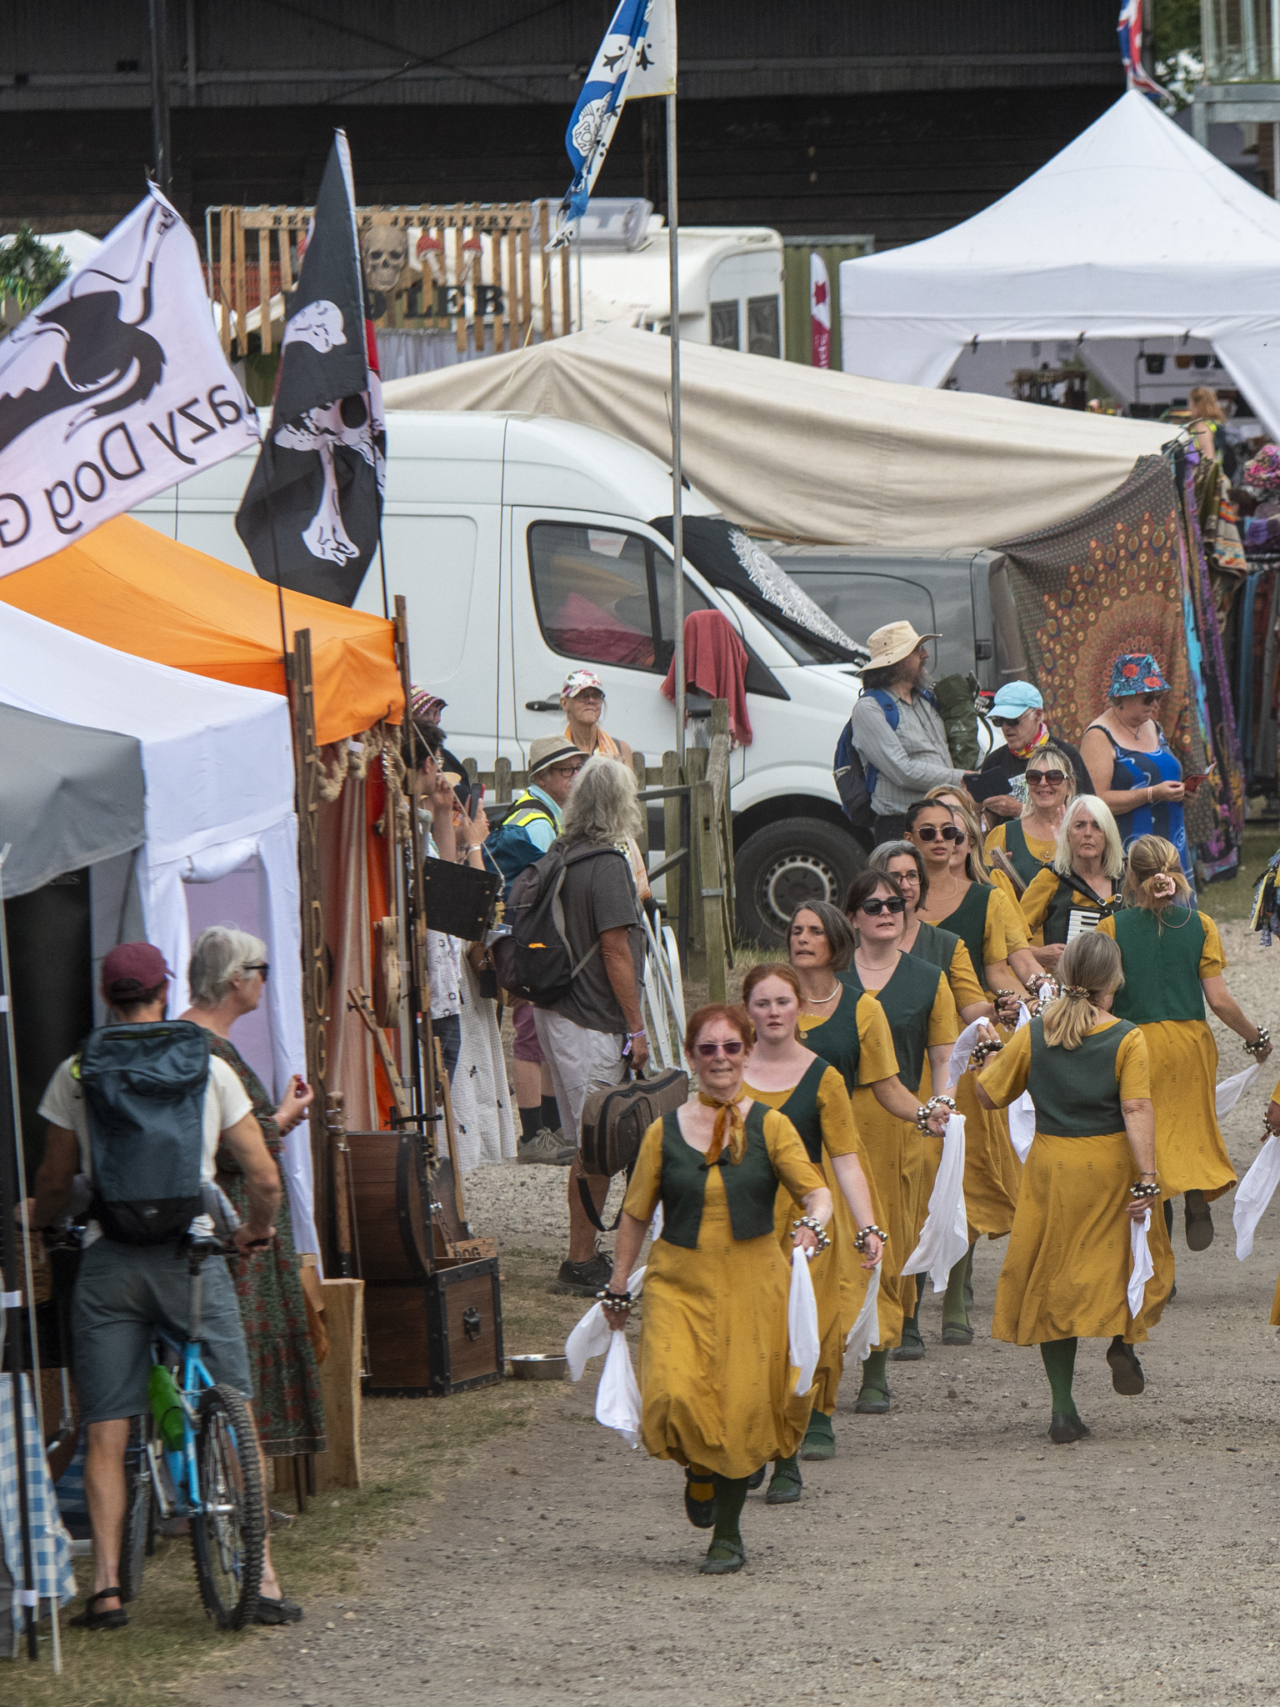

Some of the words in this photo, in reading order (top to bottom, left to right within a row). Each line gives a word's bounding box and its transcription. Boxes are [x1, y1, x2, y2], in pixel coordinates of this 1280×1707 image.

[273, 215, 373, 226] BESE
[391, 215, 513, 226] JEWELLERY
[311, 900, 327, 1080] DOG
